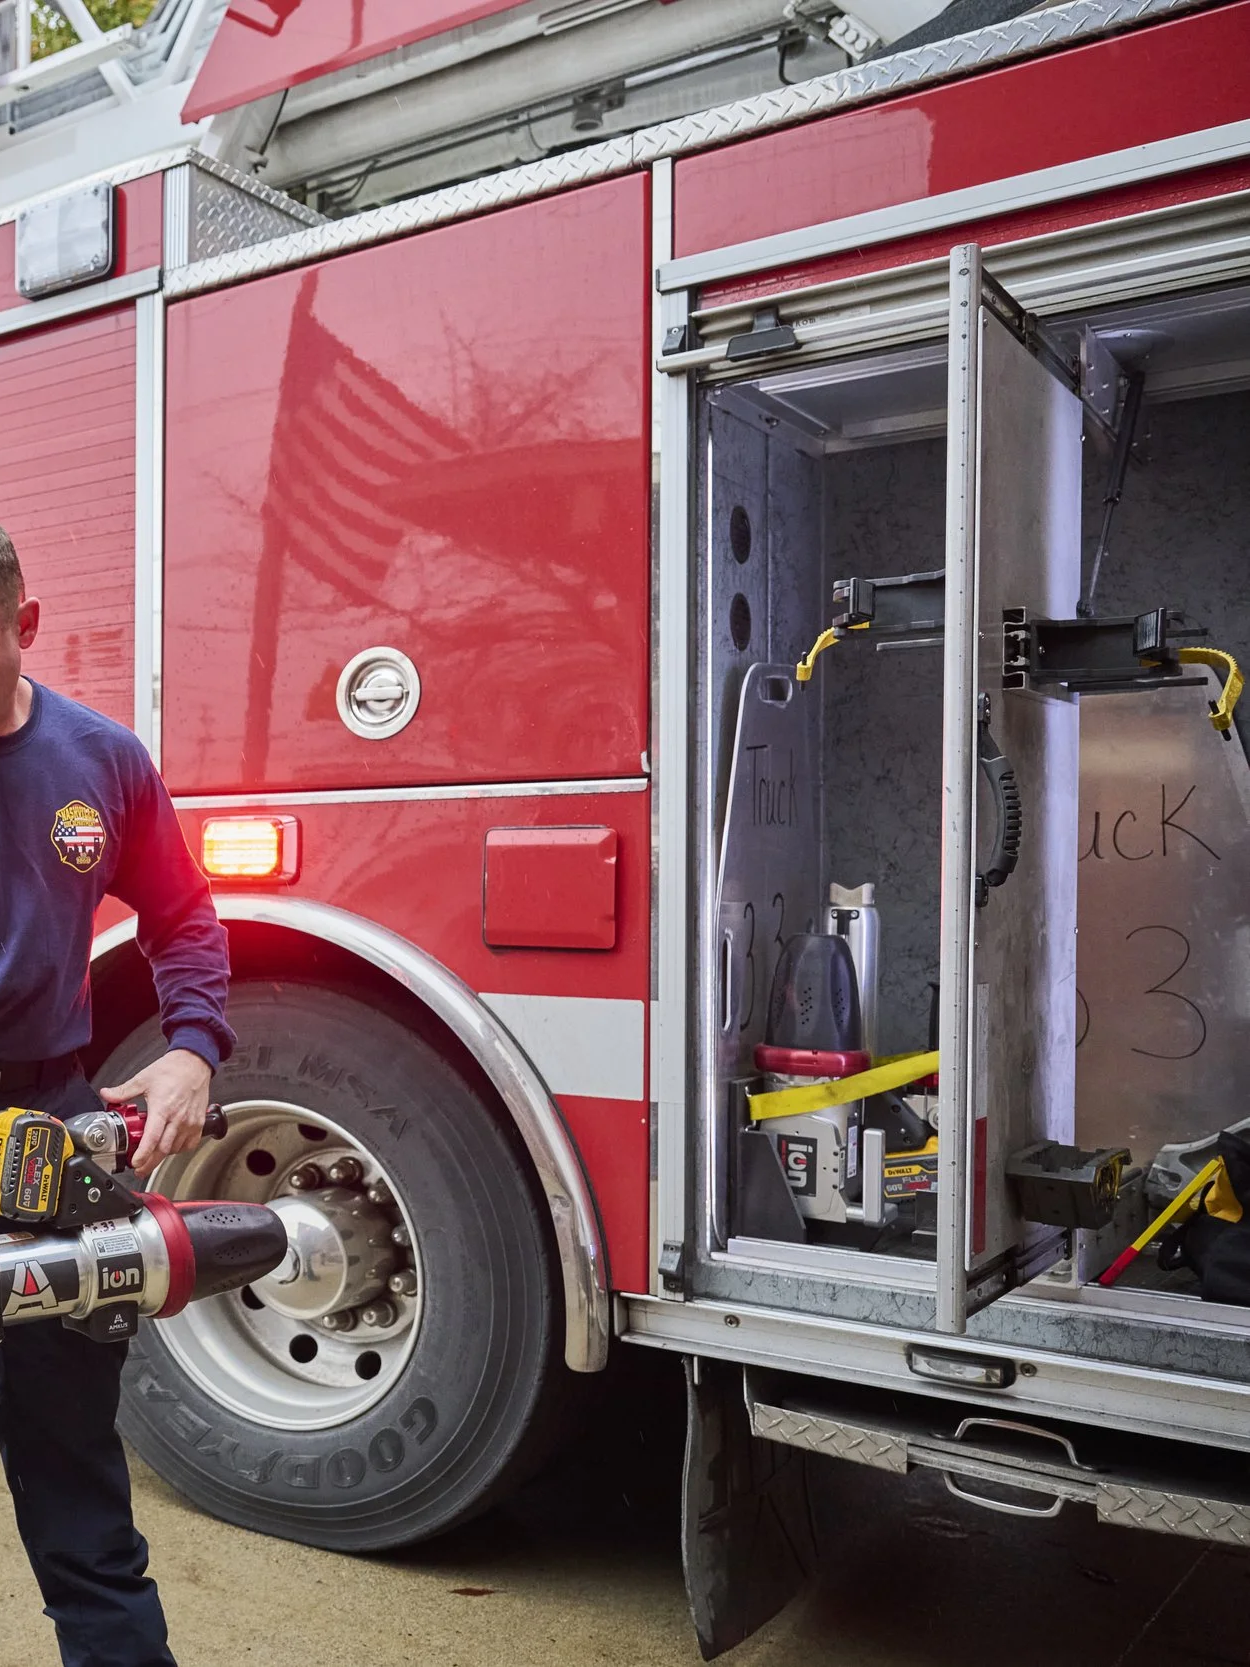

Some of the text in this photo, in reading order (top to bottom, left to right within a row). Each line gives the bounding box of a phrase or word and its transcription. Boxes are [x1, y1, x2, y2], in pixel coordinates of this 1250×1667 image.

[746, 744, 798, 827] Truck
[33, 1157, 43, 1185] FLEX
[788, 1143, 812, 1187] ion
[102, 1267, 140, 1290] ion
